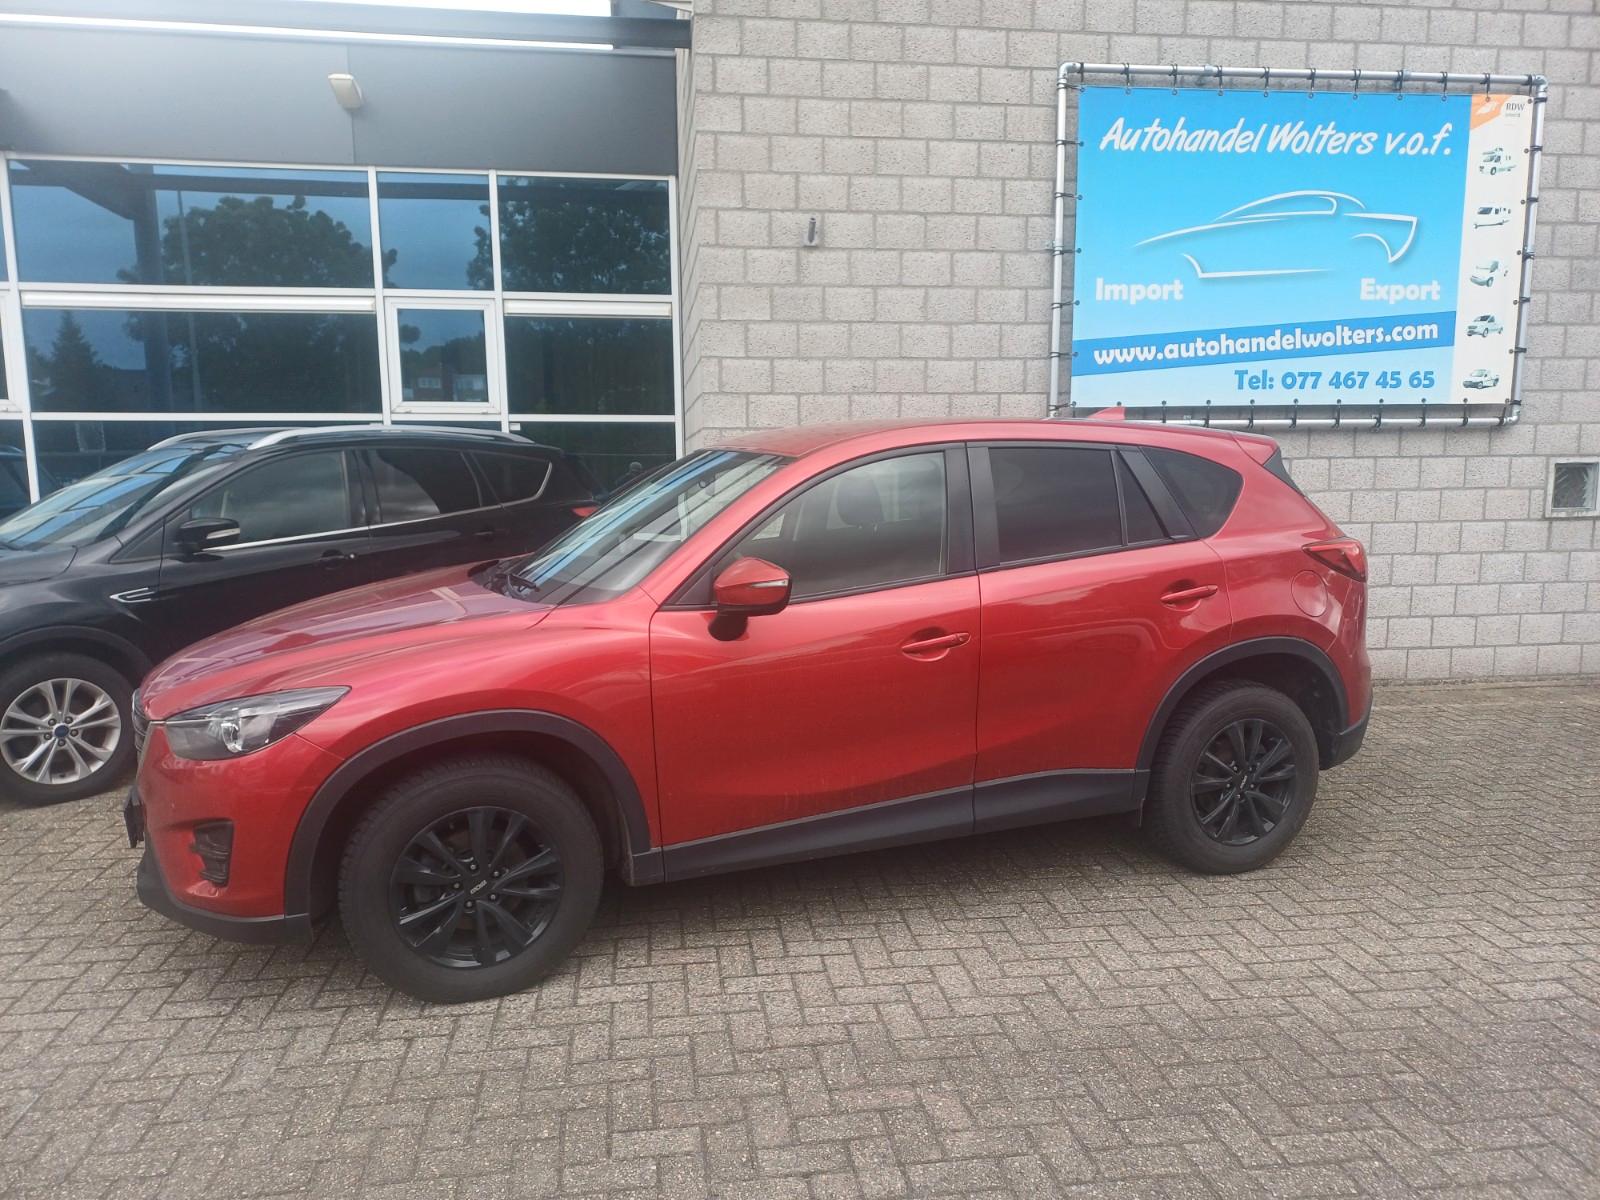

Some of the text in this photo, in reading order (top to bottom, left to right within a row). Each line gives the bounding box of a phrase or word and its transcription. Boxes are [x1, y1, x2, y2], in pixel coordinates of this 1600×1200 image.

[1505, 102, 1526, 111] RDW
[1100, 117, 1452, 155] Autohandel Wolters v.o.f.
[1095, 278, 1184, 306] Import
[1360, 279, 1441, 305] Export
[1094, 323, 1439, 365] www.autohandelwolters.com
[1235, 370, 1435, 390] Tel: 077 467 45 65
